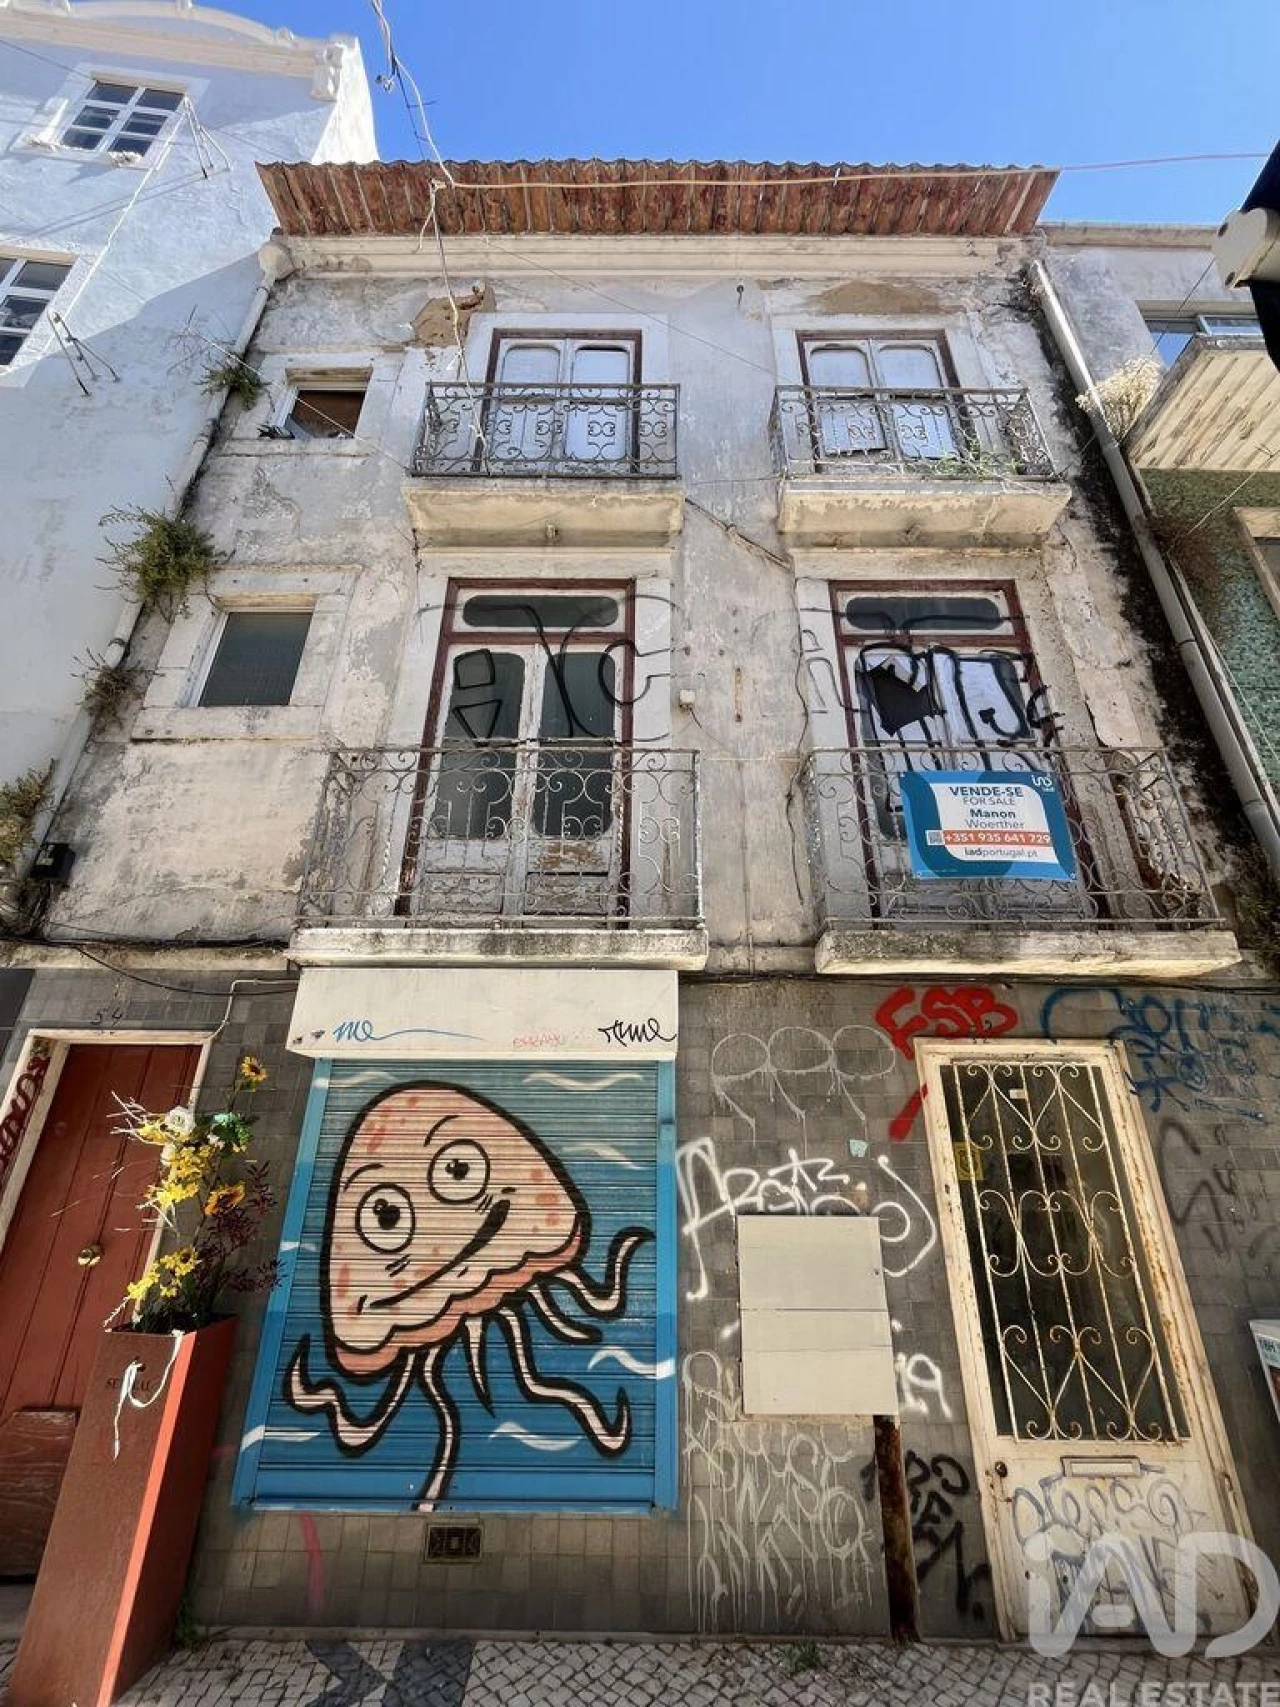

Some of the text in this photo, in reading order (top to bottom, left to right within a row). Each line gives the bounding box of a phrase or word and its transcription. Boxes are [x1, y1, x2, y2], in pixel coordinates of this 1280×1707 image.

[949, 786, 1024, 798] VENDE-SE
[962, 797, 1016, 806] FOR SALE
[969, 808, 1016, 819] Manon
[945, 832, 974, 843] +351
[1004, 832, 1026, 844] 641
[1029, 833, 1051, 844] 729
